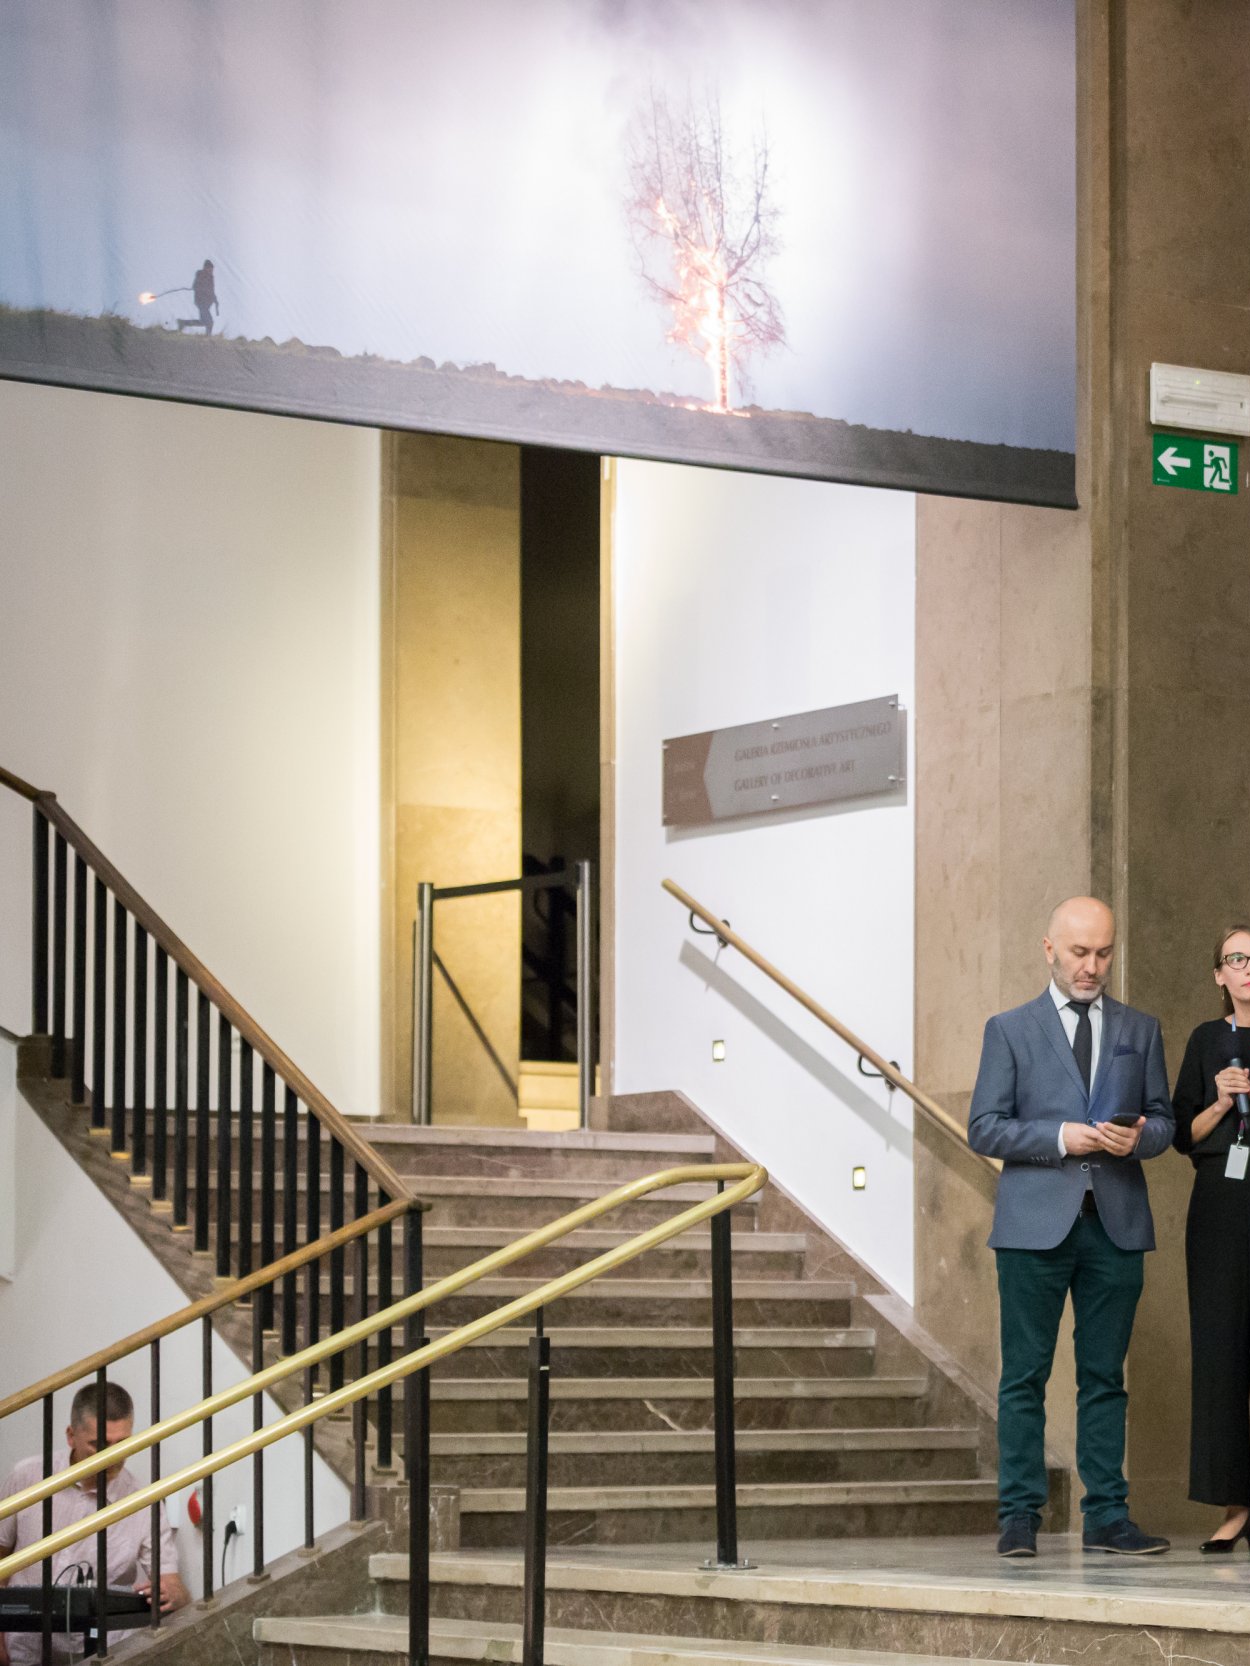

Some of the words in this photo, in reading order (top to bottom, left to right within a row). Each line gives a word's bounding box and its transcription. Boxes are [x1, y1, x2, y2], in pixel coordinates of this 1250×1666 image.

[734, 745, 769, 762] GALERIA
[734, 775, 769, 792] GALLERY
[840, 759, 855, 773] ART
